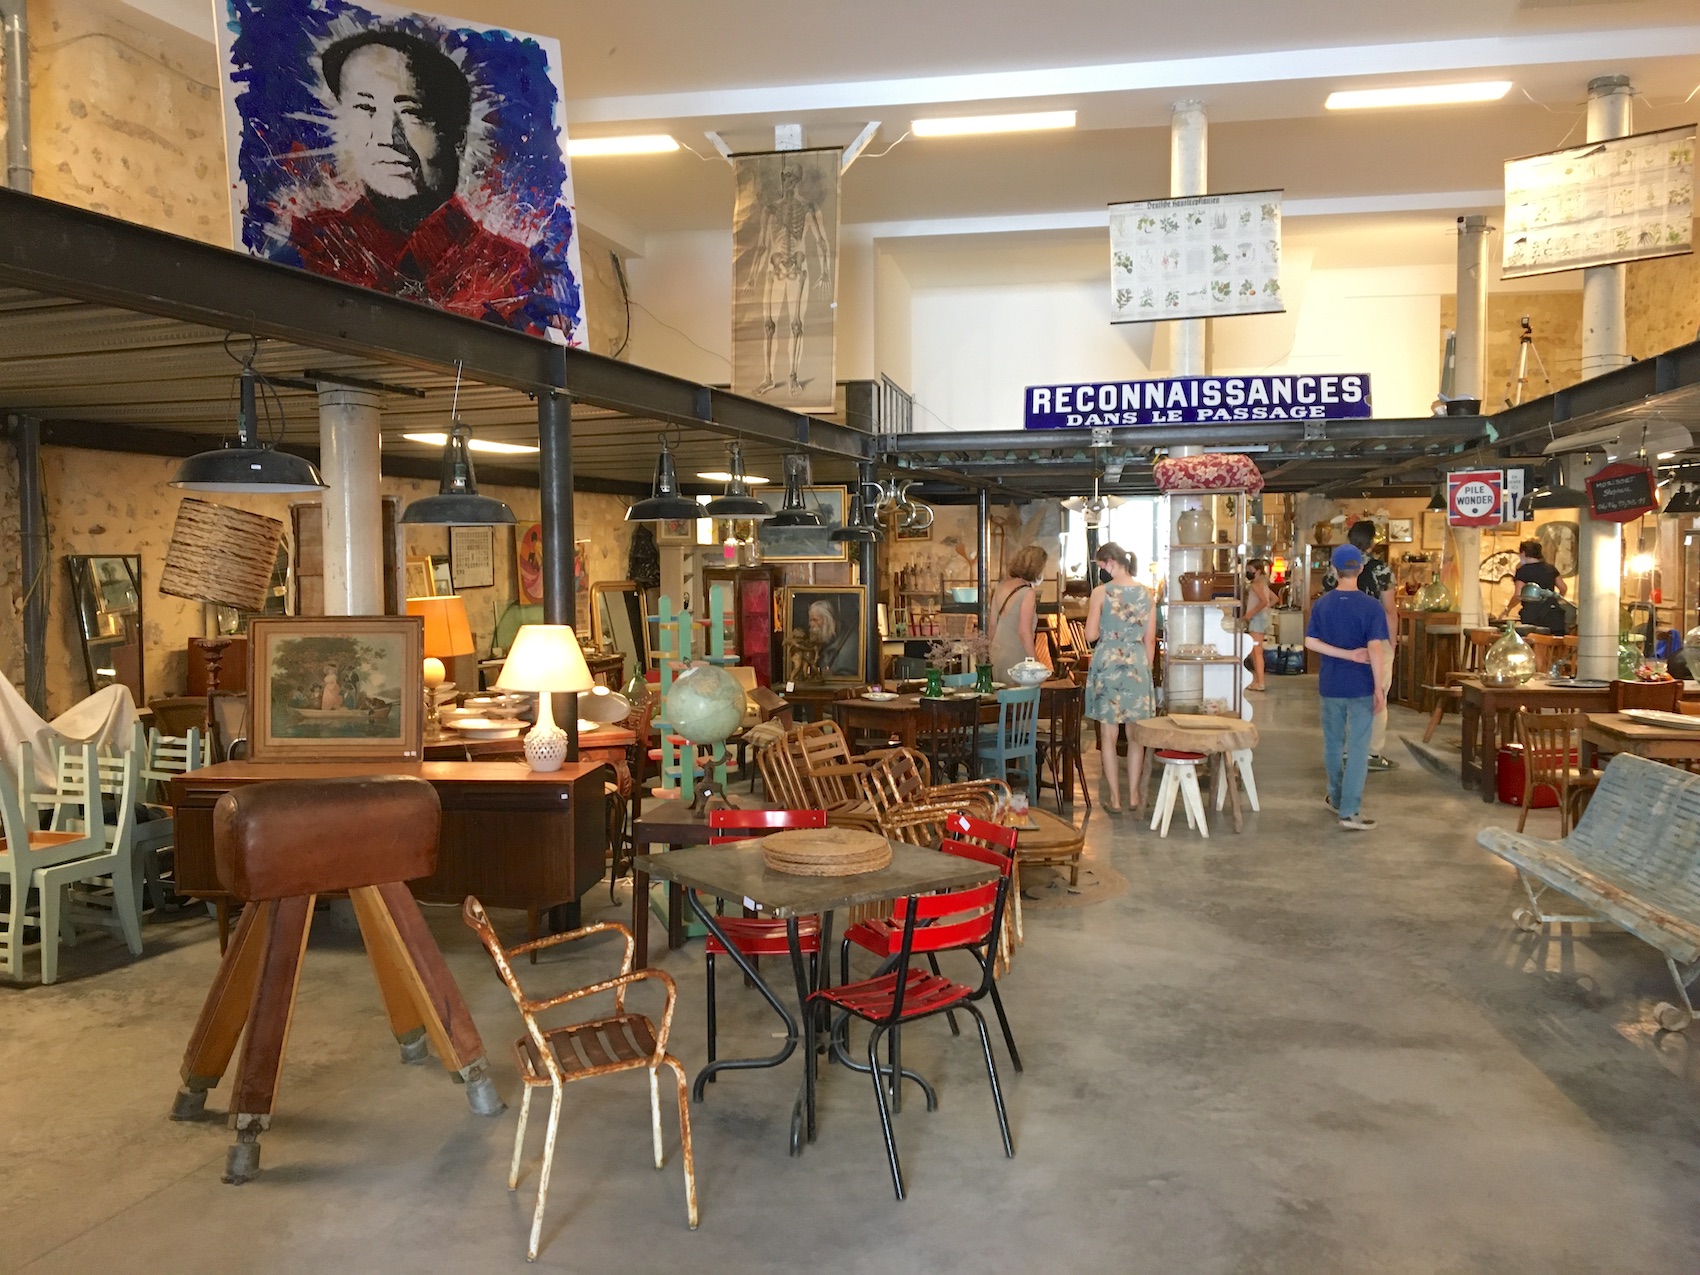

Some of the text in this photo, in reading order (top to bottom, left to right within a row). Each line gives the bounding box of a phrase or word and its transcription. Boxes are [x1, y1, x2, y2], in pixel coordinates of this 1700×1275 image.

[1033, 376, 1363, 414] RECONNAISSANCES
[1066, 405, 1326, 427] DANS LE PASSAGE
[1465, 485, 1485, 494] PILE
[1457, 495, 1493, 505] WONDER
